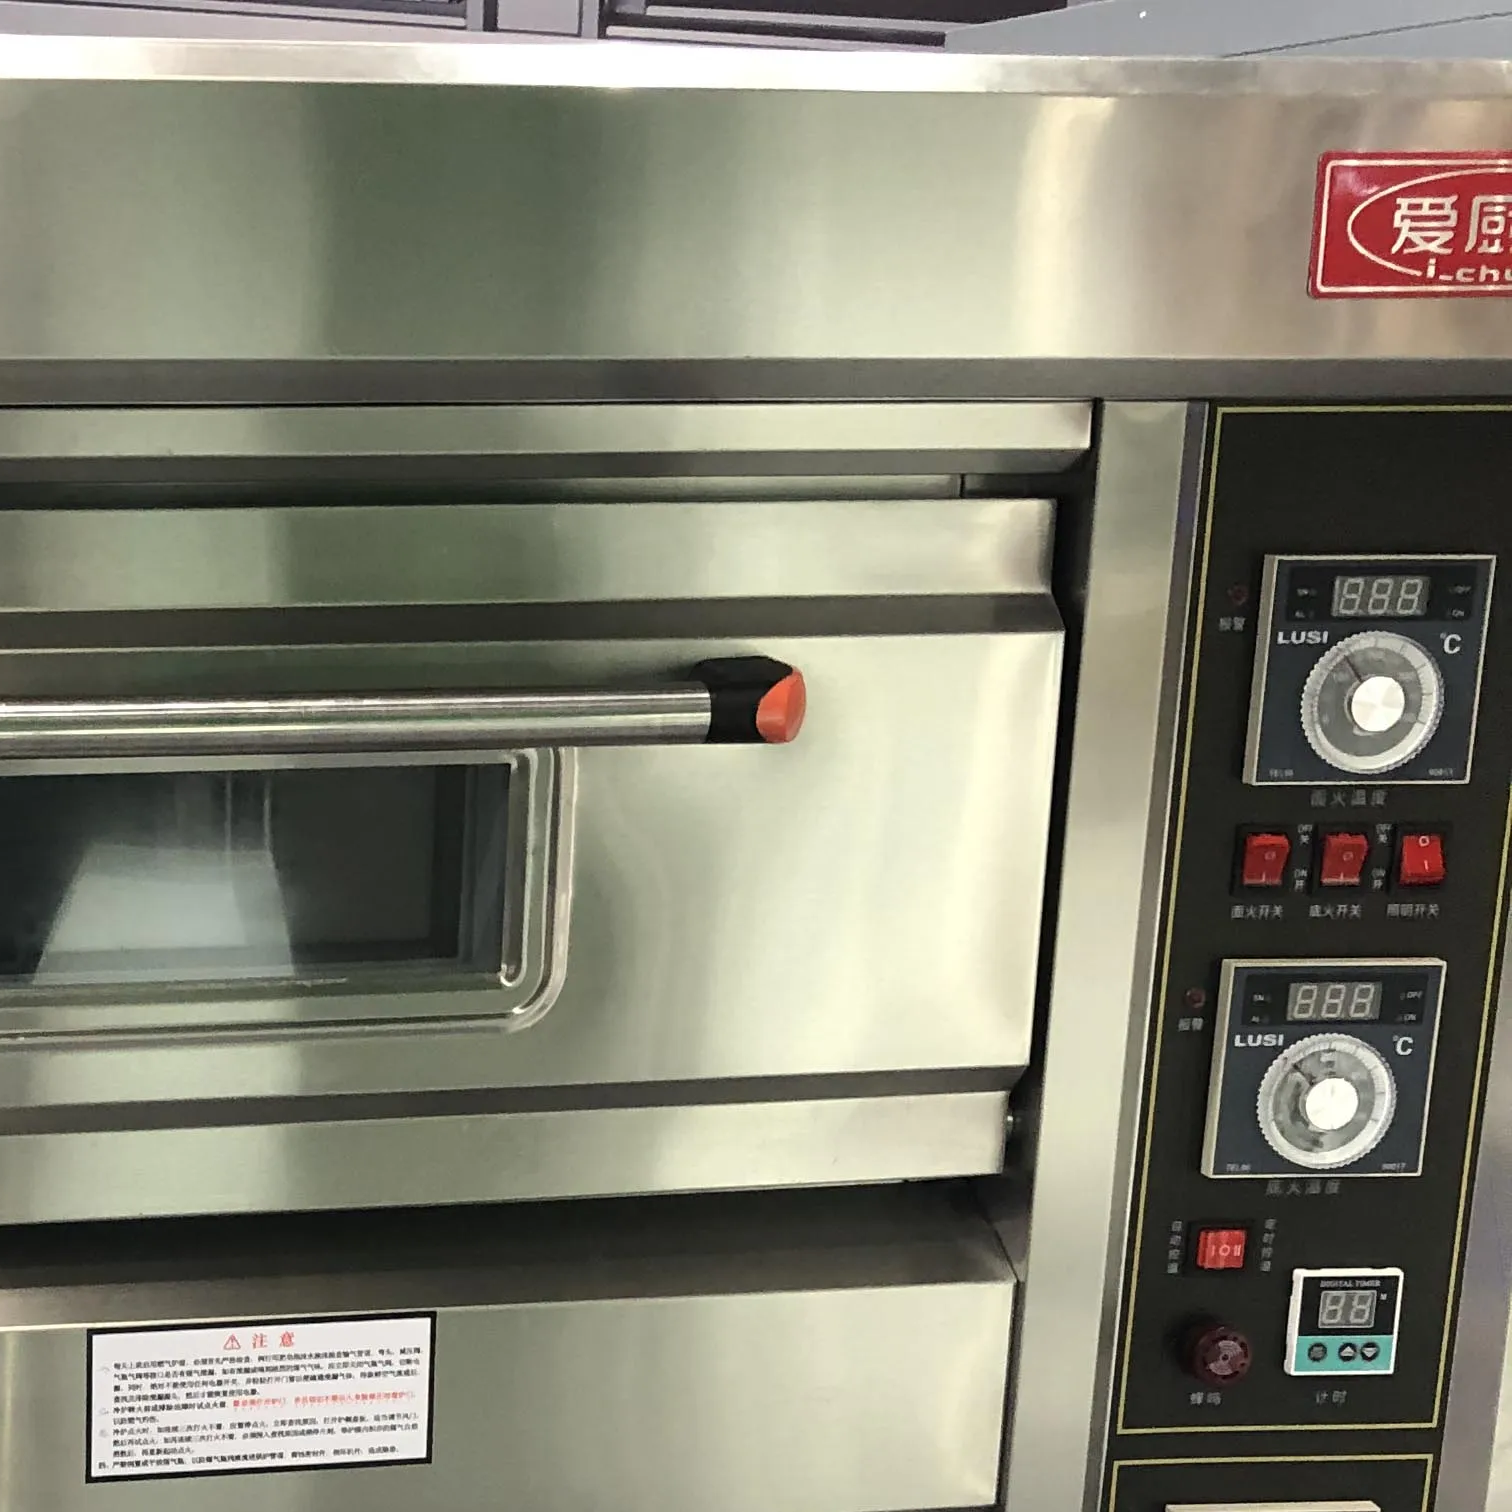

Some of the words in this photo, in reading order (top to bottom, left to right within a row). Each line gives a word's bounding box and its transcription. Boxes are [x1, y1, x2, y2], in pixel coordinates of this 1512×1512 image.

[1276, 631, 1329, 645] LUSI
[1234, 1034, 1284, 1047] LUSI
[251, 1331, 296, 1349] 注意
